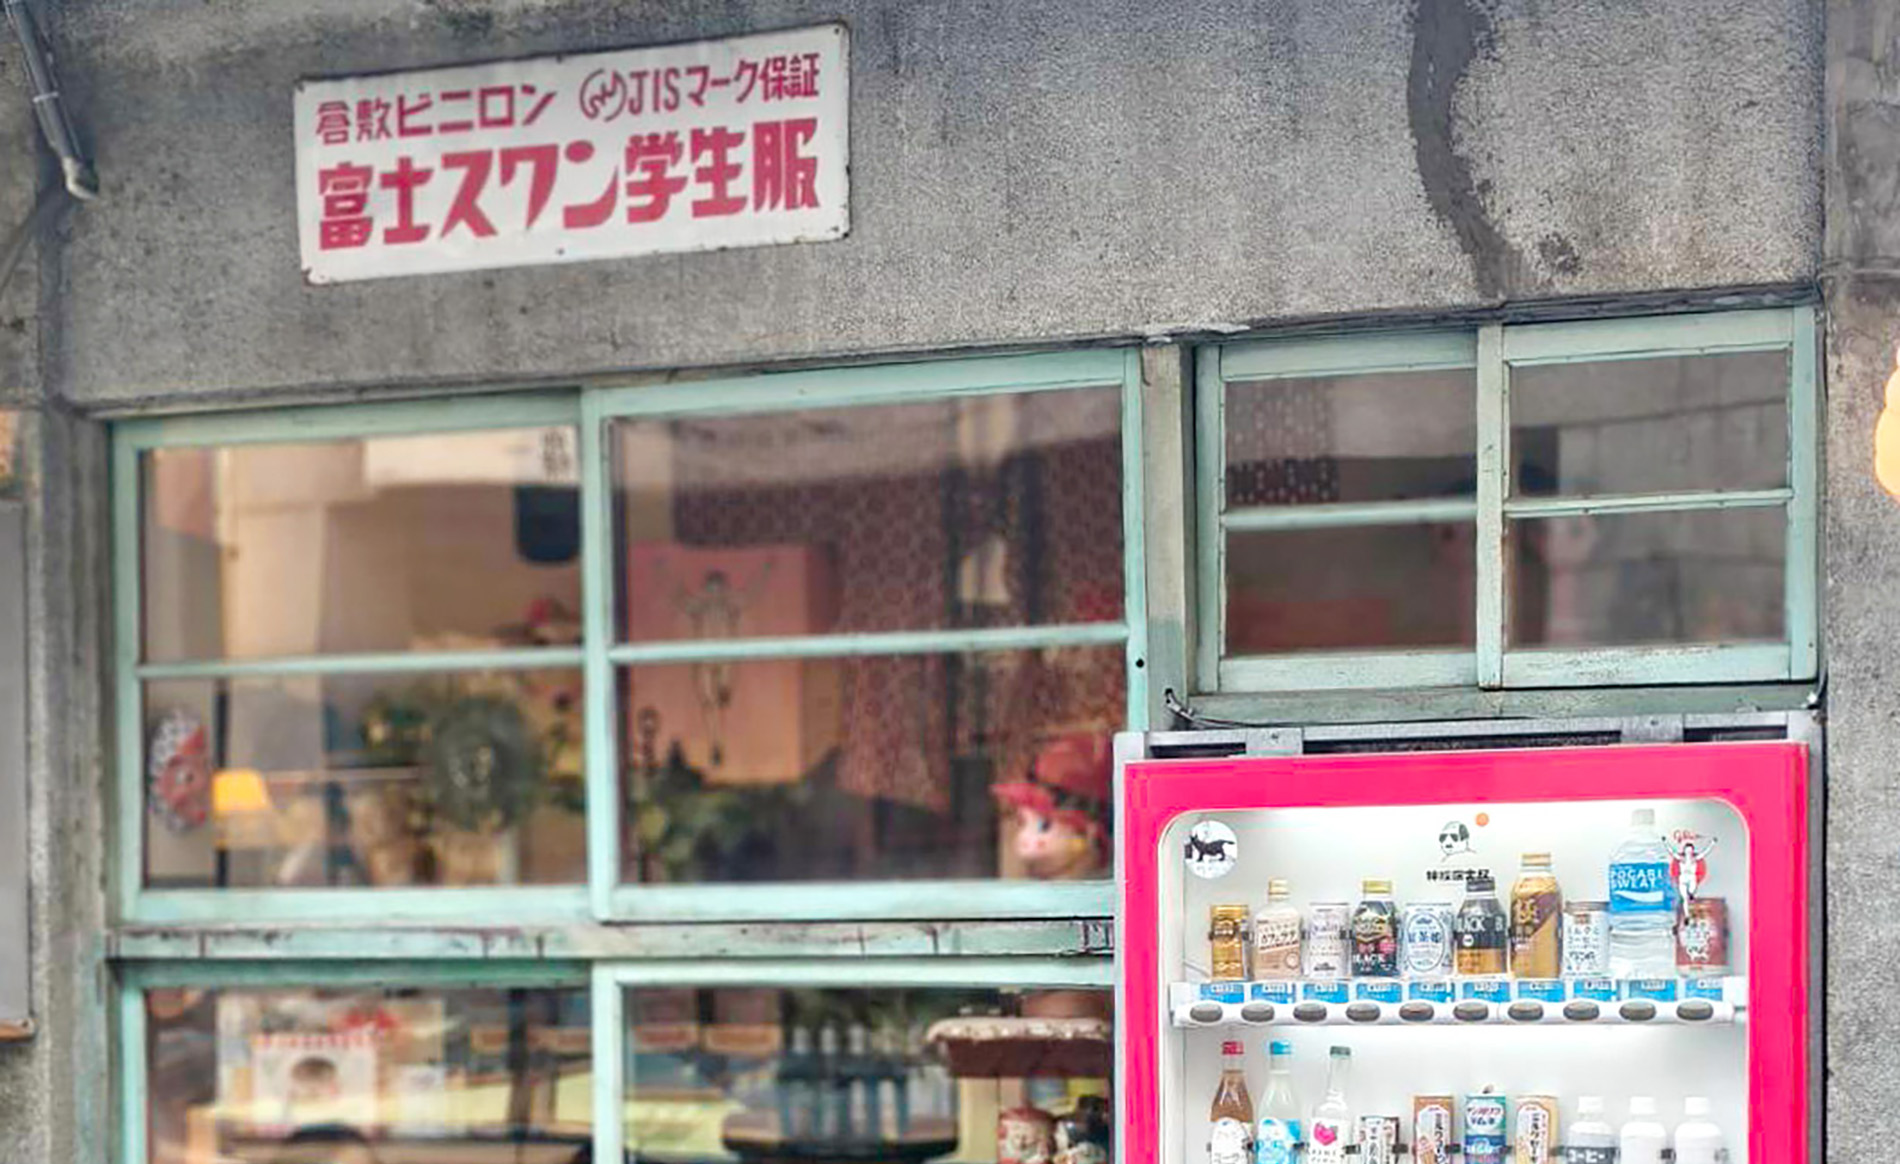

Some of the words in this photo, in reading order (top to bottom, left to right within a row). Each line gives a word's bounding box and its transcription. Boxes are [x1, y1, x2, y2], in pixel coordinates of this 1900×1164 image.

[316, 83, 559, 145] 倉敷ビニロン
[628, 53, 821, 116] JISマーク保証
[318, 118, 821, 251] 富士スワン学生服
